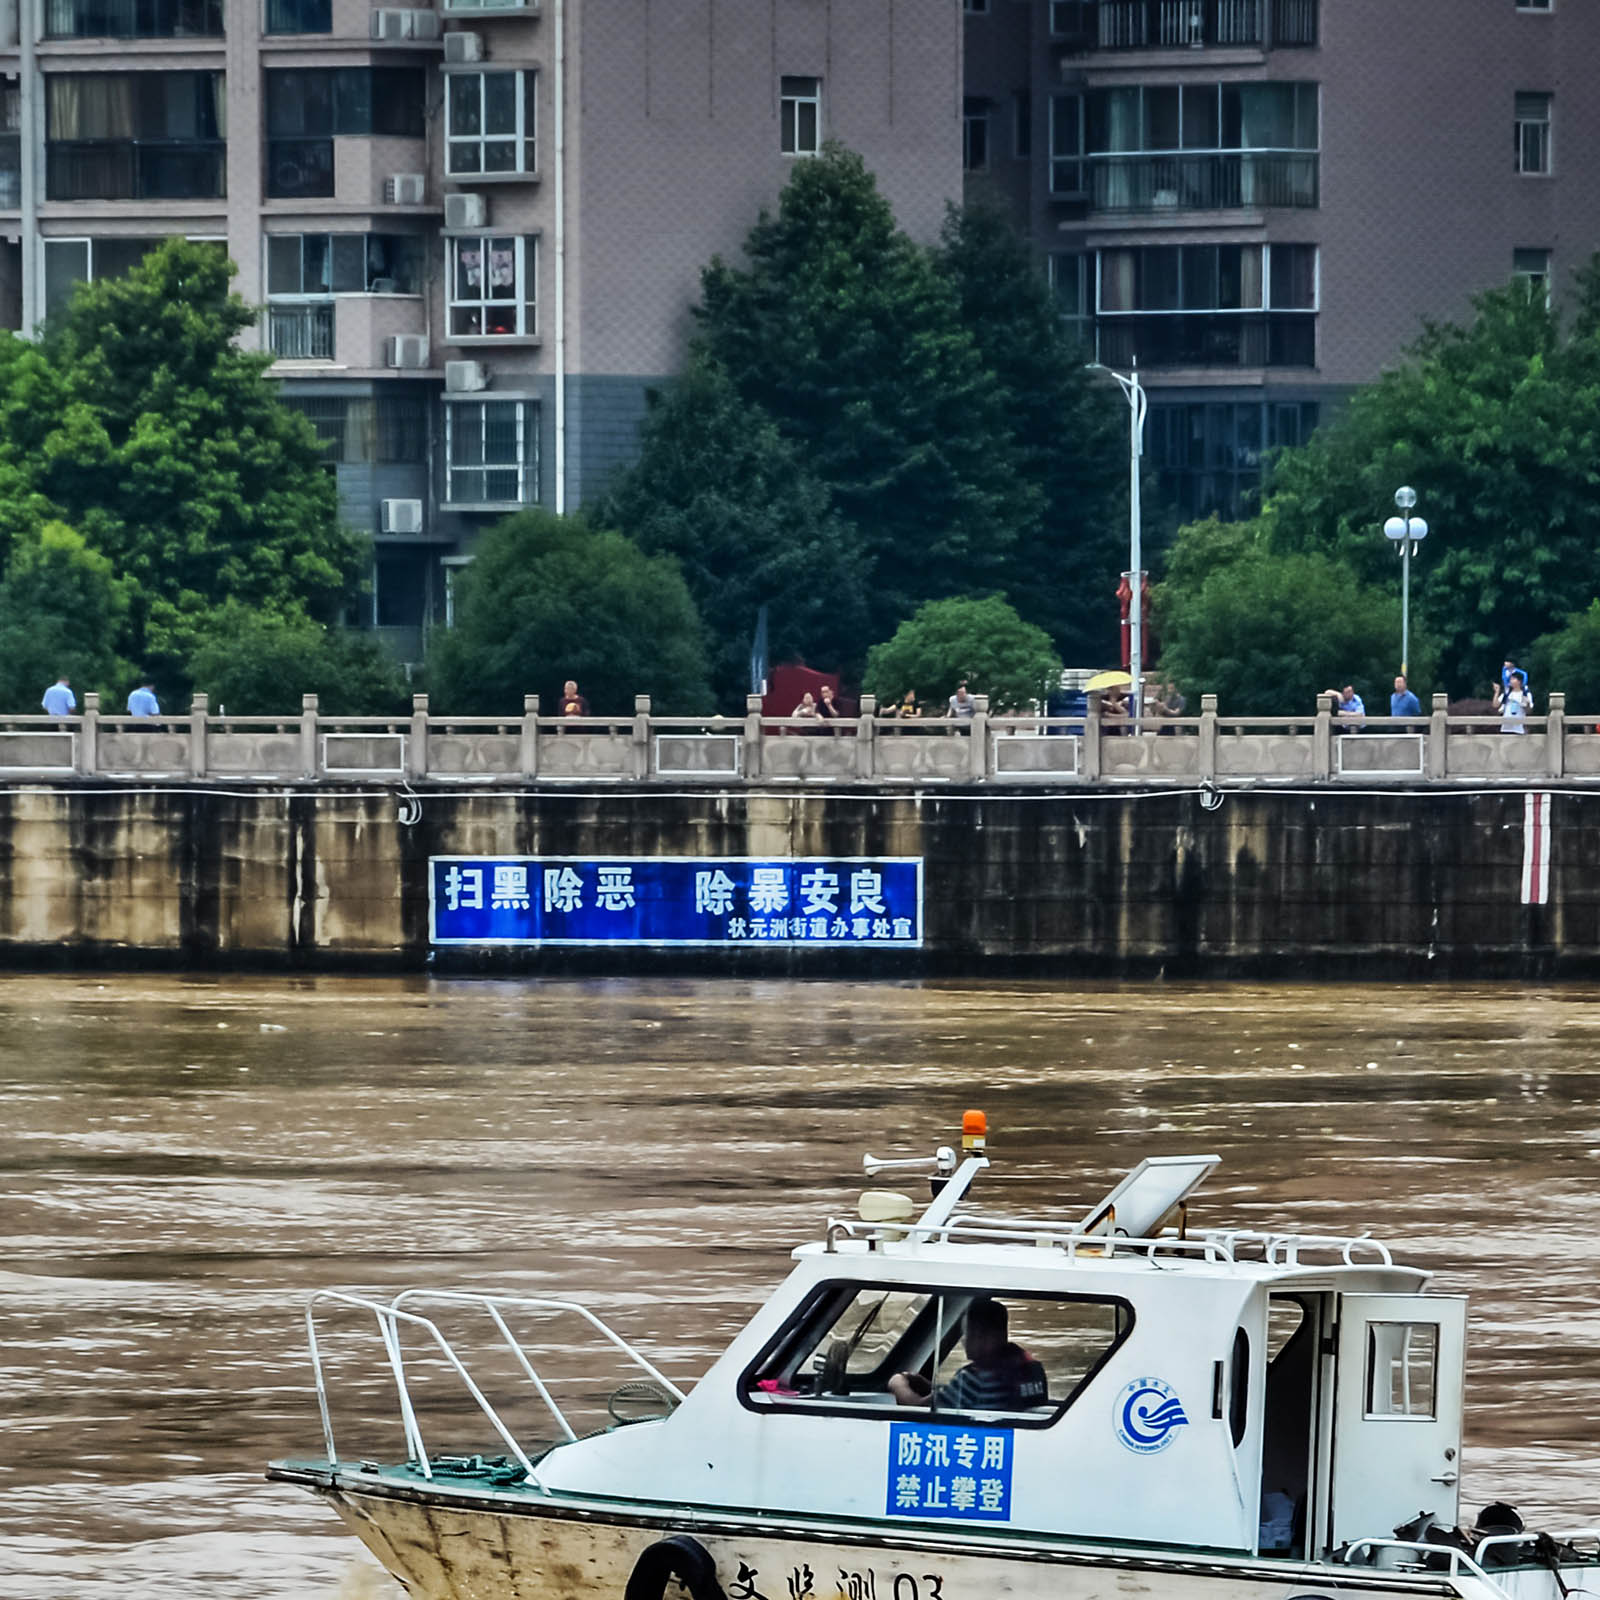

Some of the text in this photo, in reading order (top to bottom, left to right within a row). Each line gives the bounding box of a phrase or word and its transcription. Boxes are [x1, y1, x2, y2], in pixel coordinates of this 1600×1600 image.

[445, 866, 886, 915] 扫黑除恶 除暴安良
[728, 917, 912, 939] 状元洲街道办事处宣
[898, 1432, 1005, 1470] 防汛专用
[895, 1474, 1004, 1512] 禁止攀登
